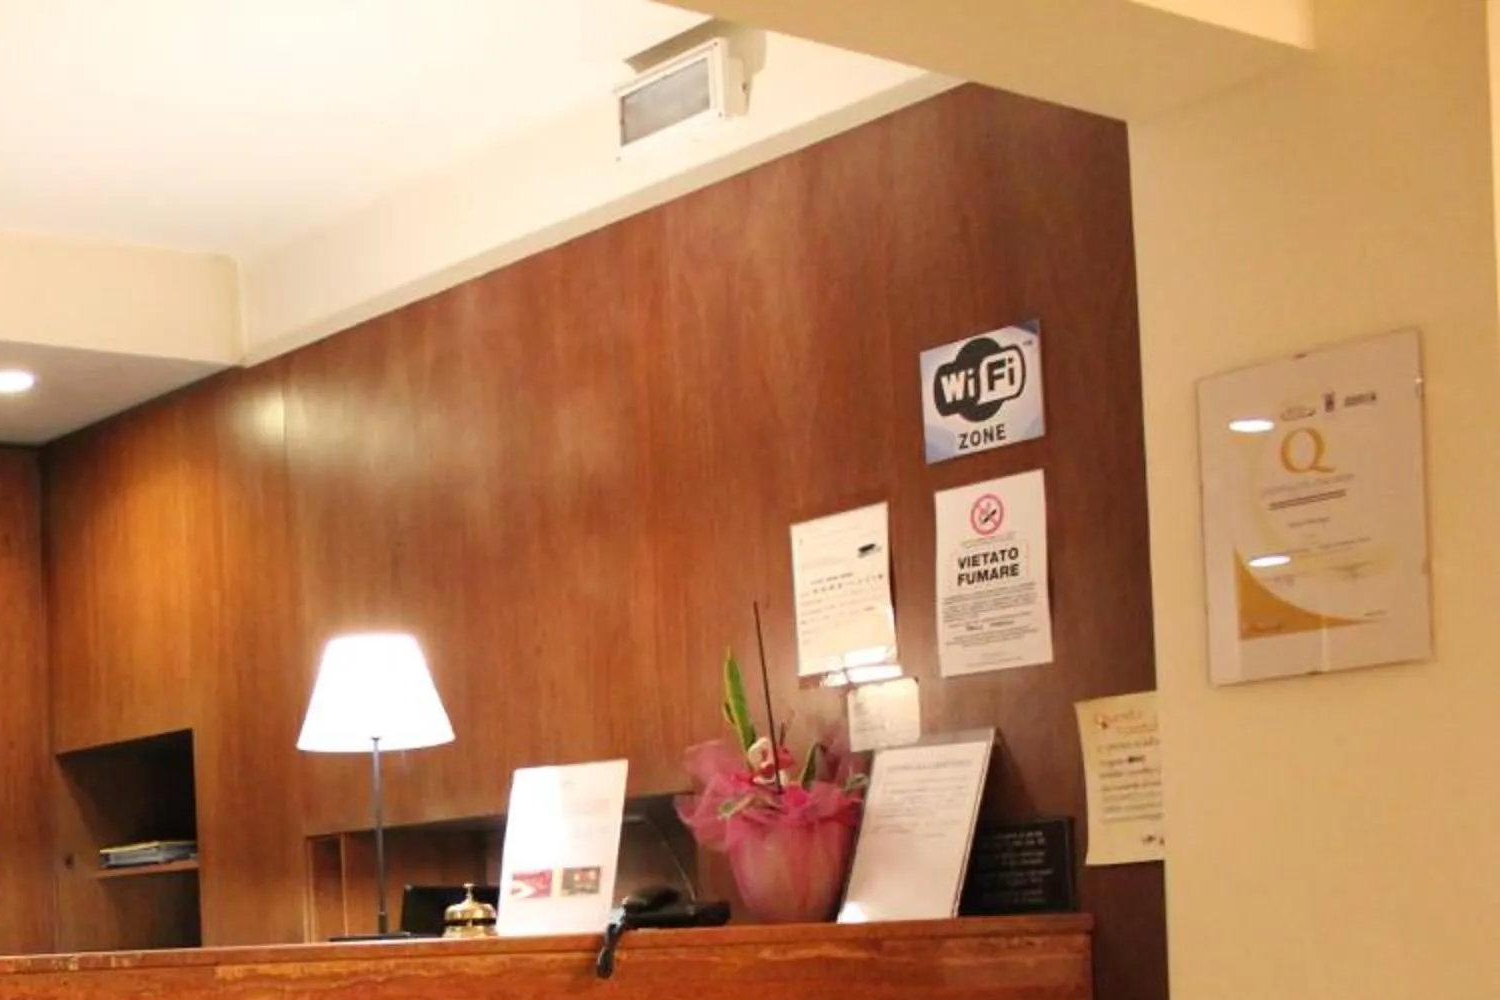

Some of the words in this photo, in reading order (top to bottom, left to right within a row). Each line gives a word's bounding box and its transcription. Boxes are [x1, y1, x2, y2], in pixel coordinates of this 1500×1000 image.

[958, 423, 1006, 450] ZONE
[1280, 427, 1337, 474] Q
[957, 547, 1019, 569] VIETATO
[957, 564, 1020, 587] FUMARE
